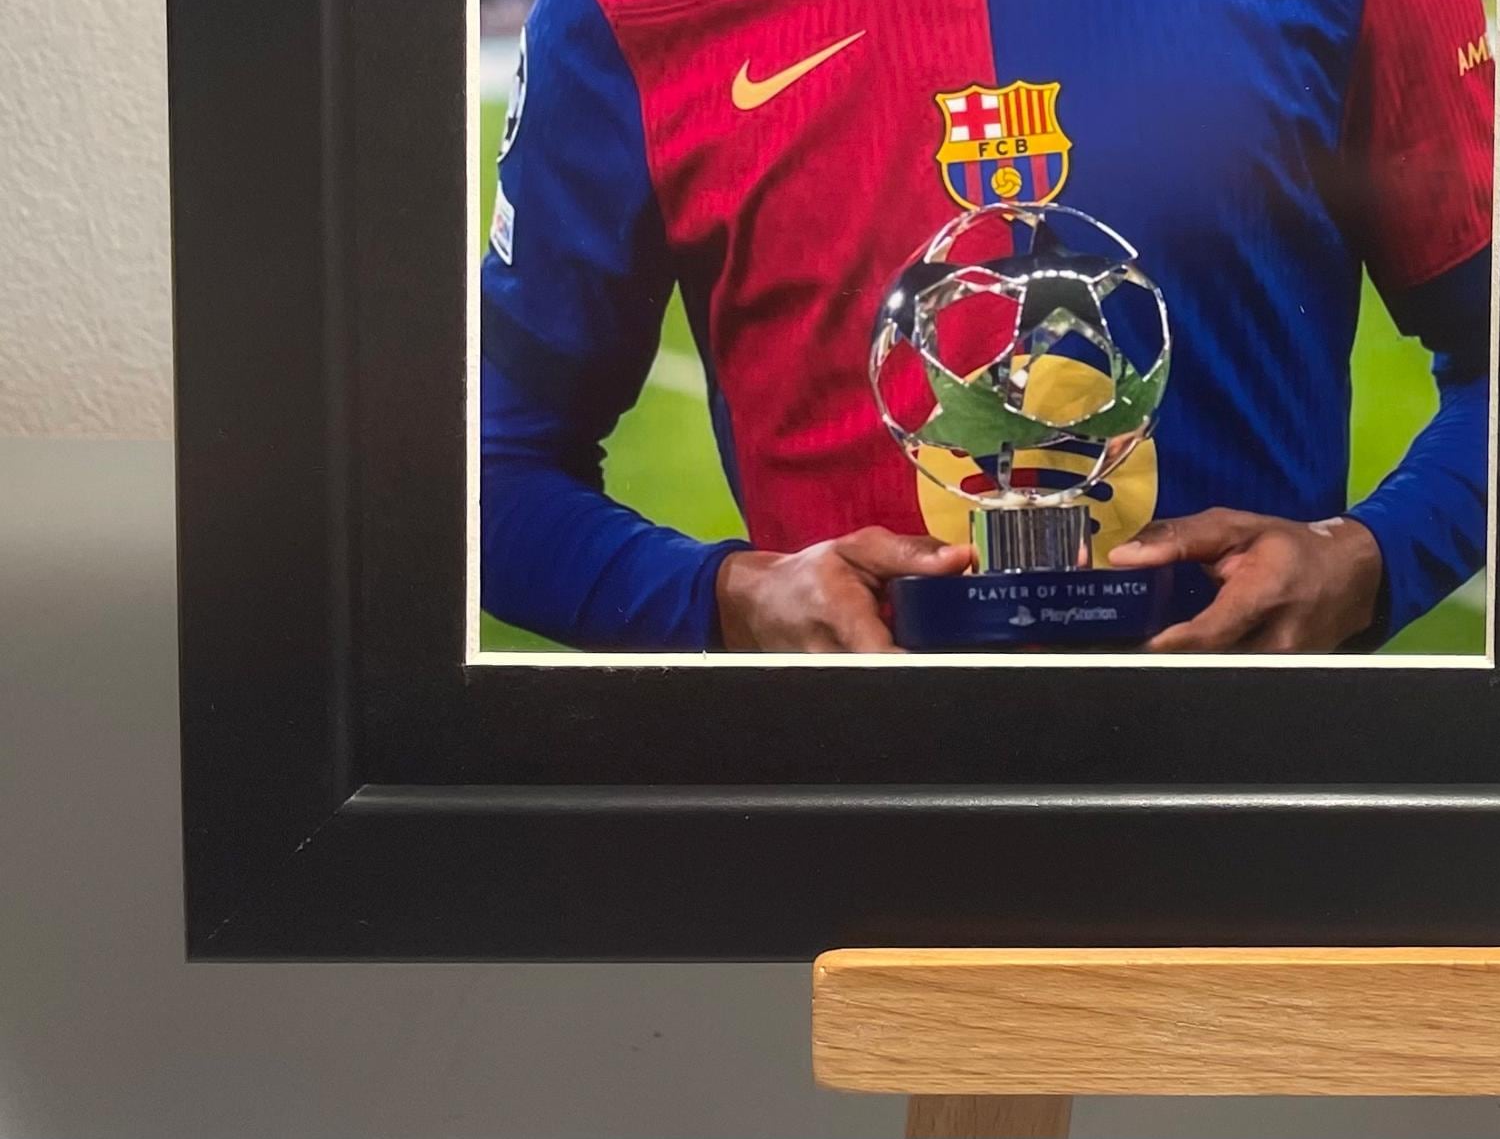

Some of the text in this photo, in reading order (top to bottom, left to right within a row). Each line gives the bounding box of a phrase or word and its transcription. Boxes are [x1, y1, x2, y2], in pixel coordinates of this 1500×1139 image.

[1457, 33, 1491, 77] AM
[977, 138, 1029, 158] FCB
[967, 581, 1148, 601] PLAYER OF THE MATCH
